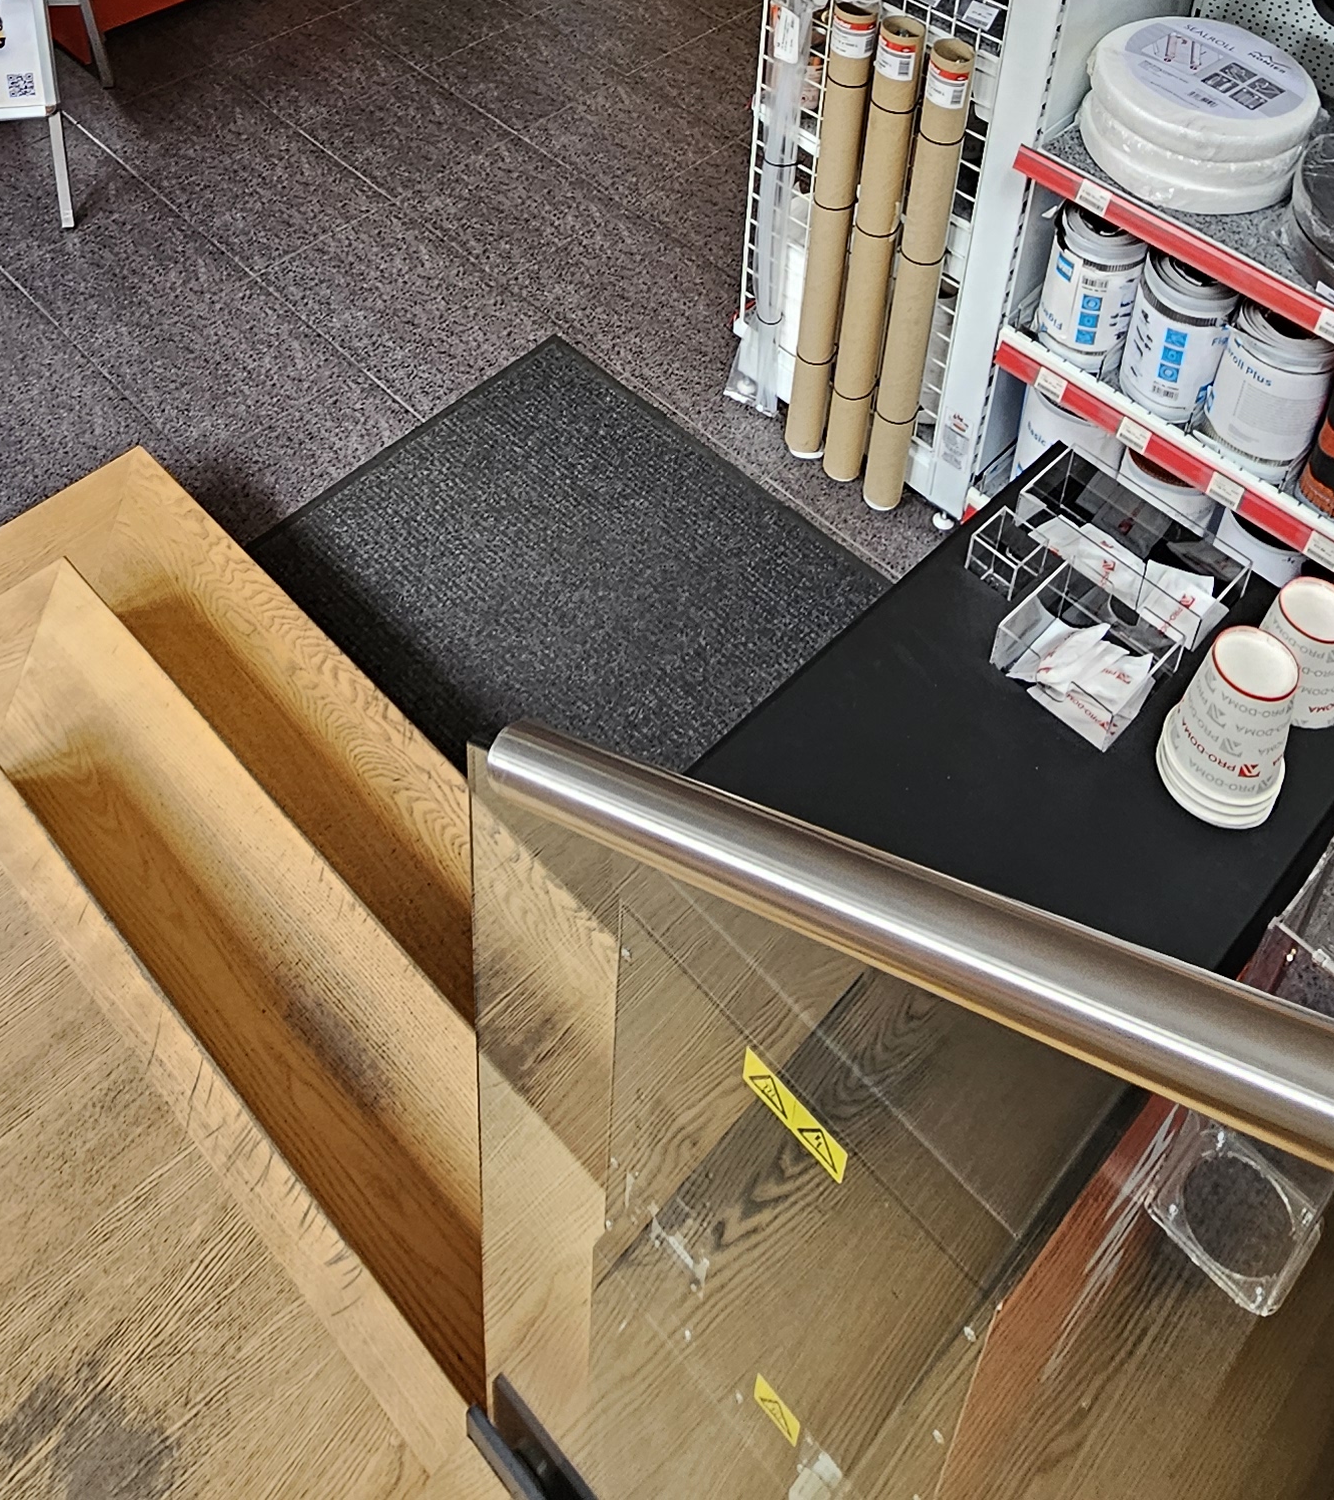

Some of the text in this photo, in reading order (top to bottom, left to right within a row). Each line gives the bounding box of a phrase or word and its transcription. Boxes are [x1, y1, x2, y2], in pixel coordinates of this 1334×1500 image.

[1183, 24, 1237, 53] SEALROLL
[1245, 366, 1273, 387] Plus
[1272, 618, 1326, 660] PRO-DOMA
[1181, 716, 1236, 773] PRO-DOMA
[1188, 756, 1258, 793] PRO-DOMA
